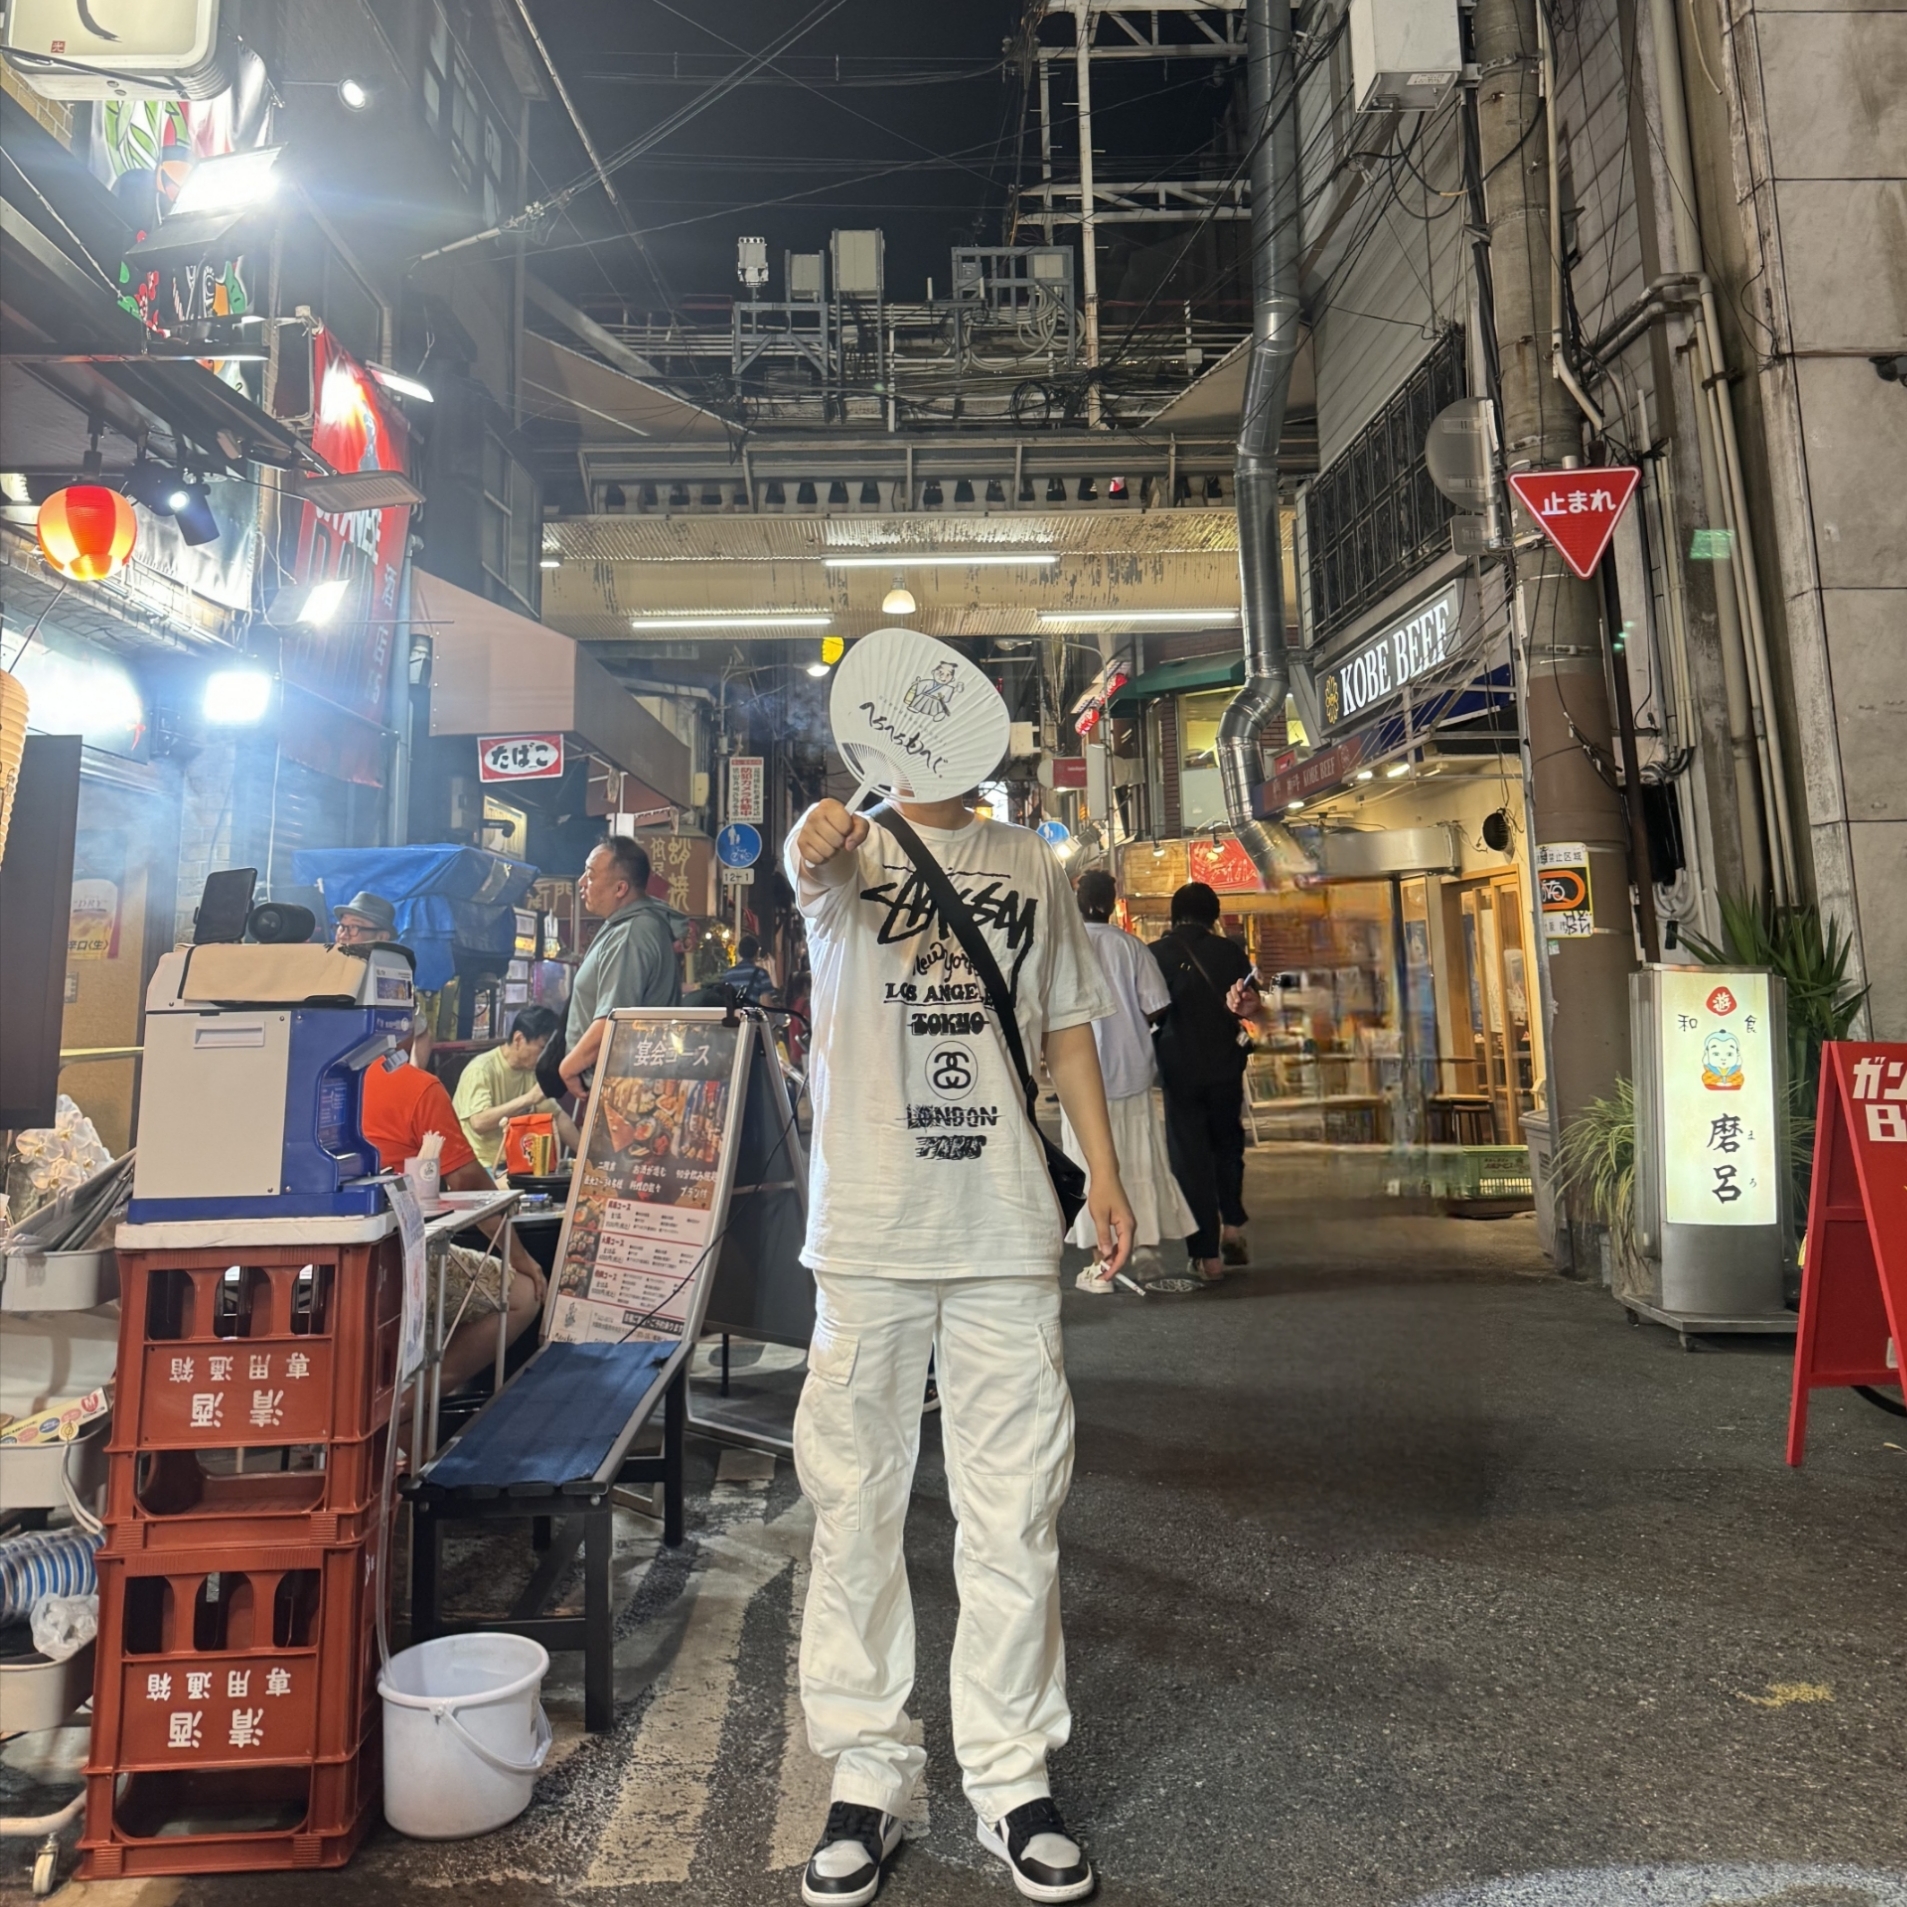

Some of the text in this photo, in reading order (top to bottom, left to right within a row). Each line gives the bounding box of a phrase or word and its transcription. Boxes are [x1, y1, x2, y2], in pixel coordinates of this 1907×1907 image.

[1541, 489, 1617, 516] 止まれ
[1340, 599, 1449, 717] KOBE BEEF
[491, 742, 549, 769] たばこ
[885, 983, 917, 999] LOS
[910, 1012, 985, 1036] TOKYO
[906, 1104, 998, 1131] LONDON
[1707, 1113, 1743, 1204] 磨呂
[190, 1388, 285, 1429] 清酒
[167, 1707, 265, 1750] 清酒
